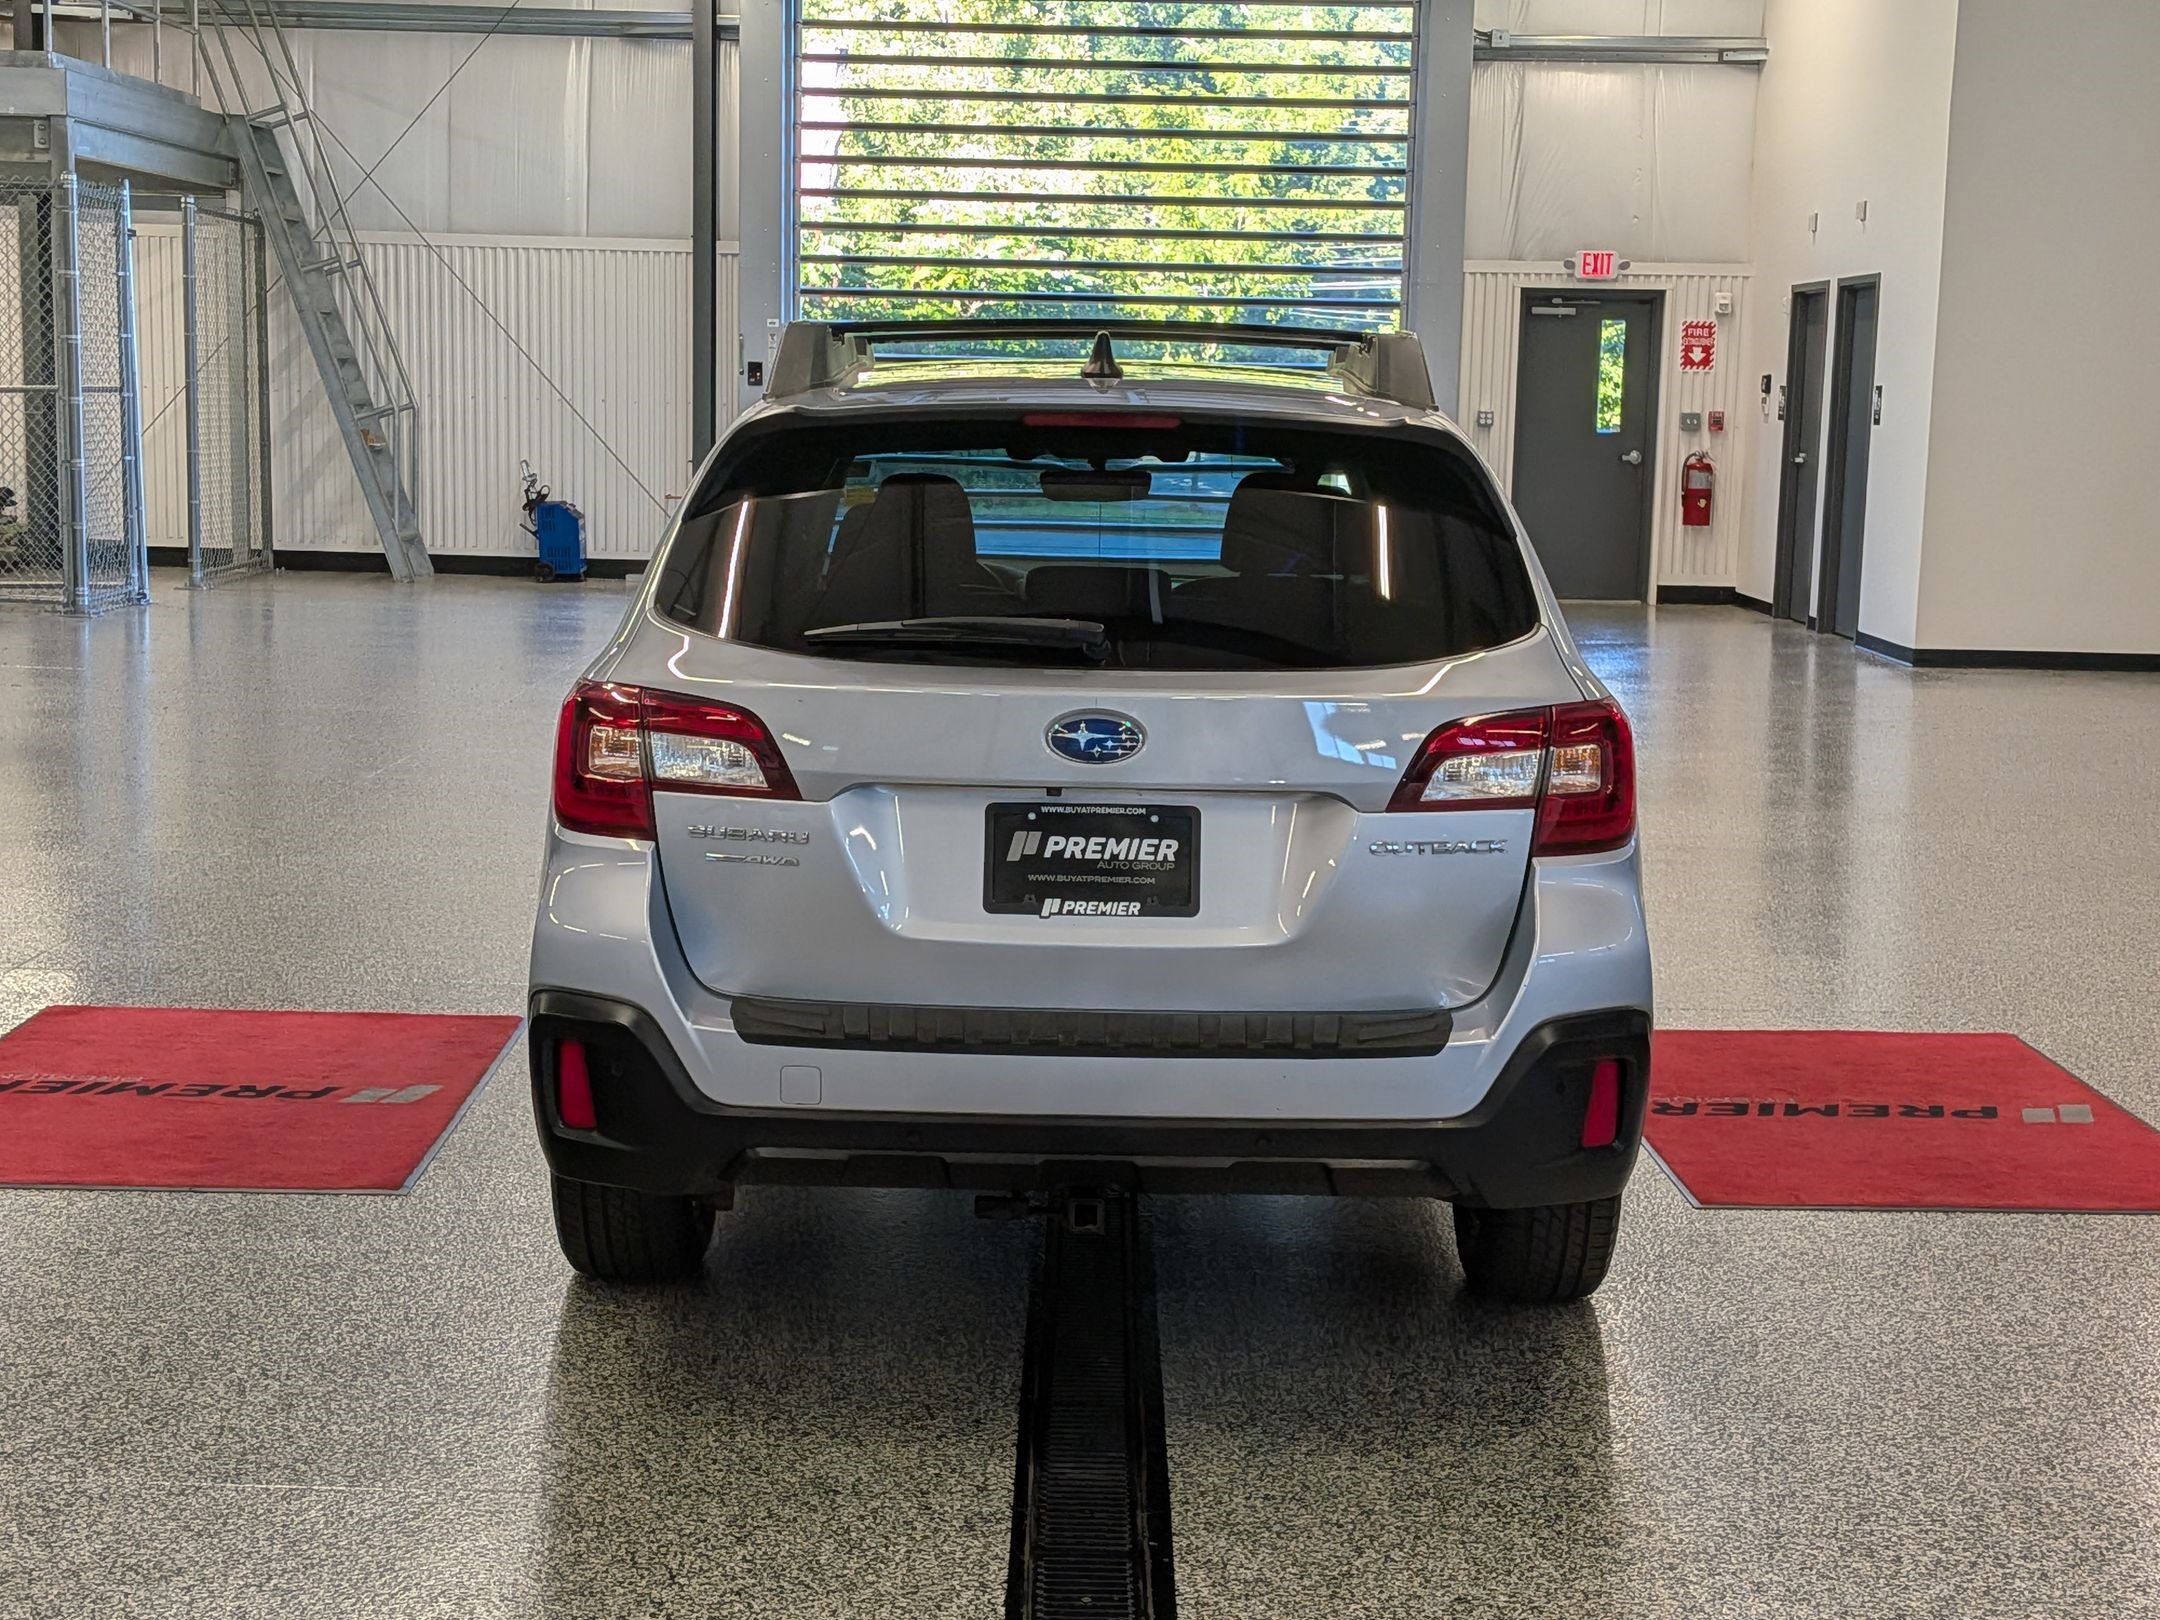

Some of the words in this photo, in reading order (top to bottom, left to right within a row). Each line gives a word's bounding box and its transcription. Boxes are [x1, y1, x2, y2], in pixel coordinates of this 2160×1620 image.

[1582, 252, 1614, 275] EXIT
[1687, 327, 1710, 337] FIRE
[1041, 805, 1147, 816] WWW.BUYATPREMIER.COM
[687, 825, 810, 845] SUBARU
[1043, 835, 1179, 862] PREMIER
[1368, 839, 1508, 857] OUTBACK
[1096, 861, 1130, 871] AUTO
[1131, 861, 1176, 872] GROUP
[1027, 873, 1156, 885] WWW.BUYATPREMIER.COM
[1062, 900, 1141, 916] PREMIER
